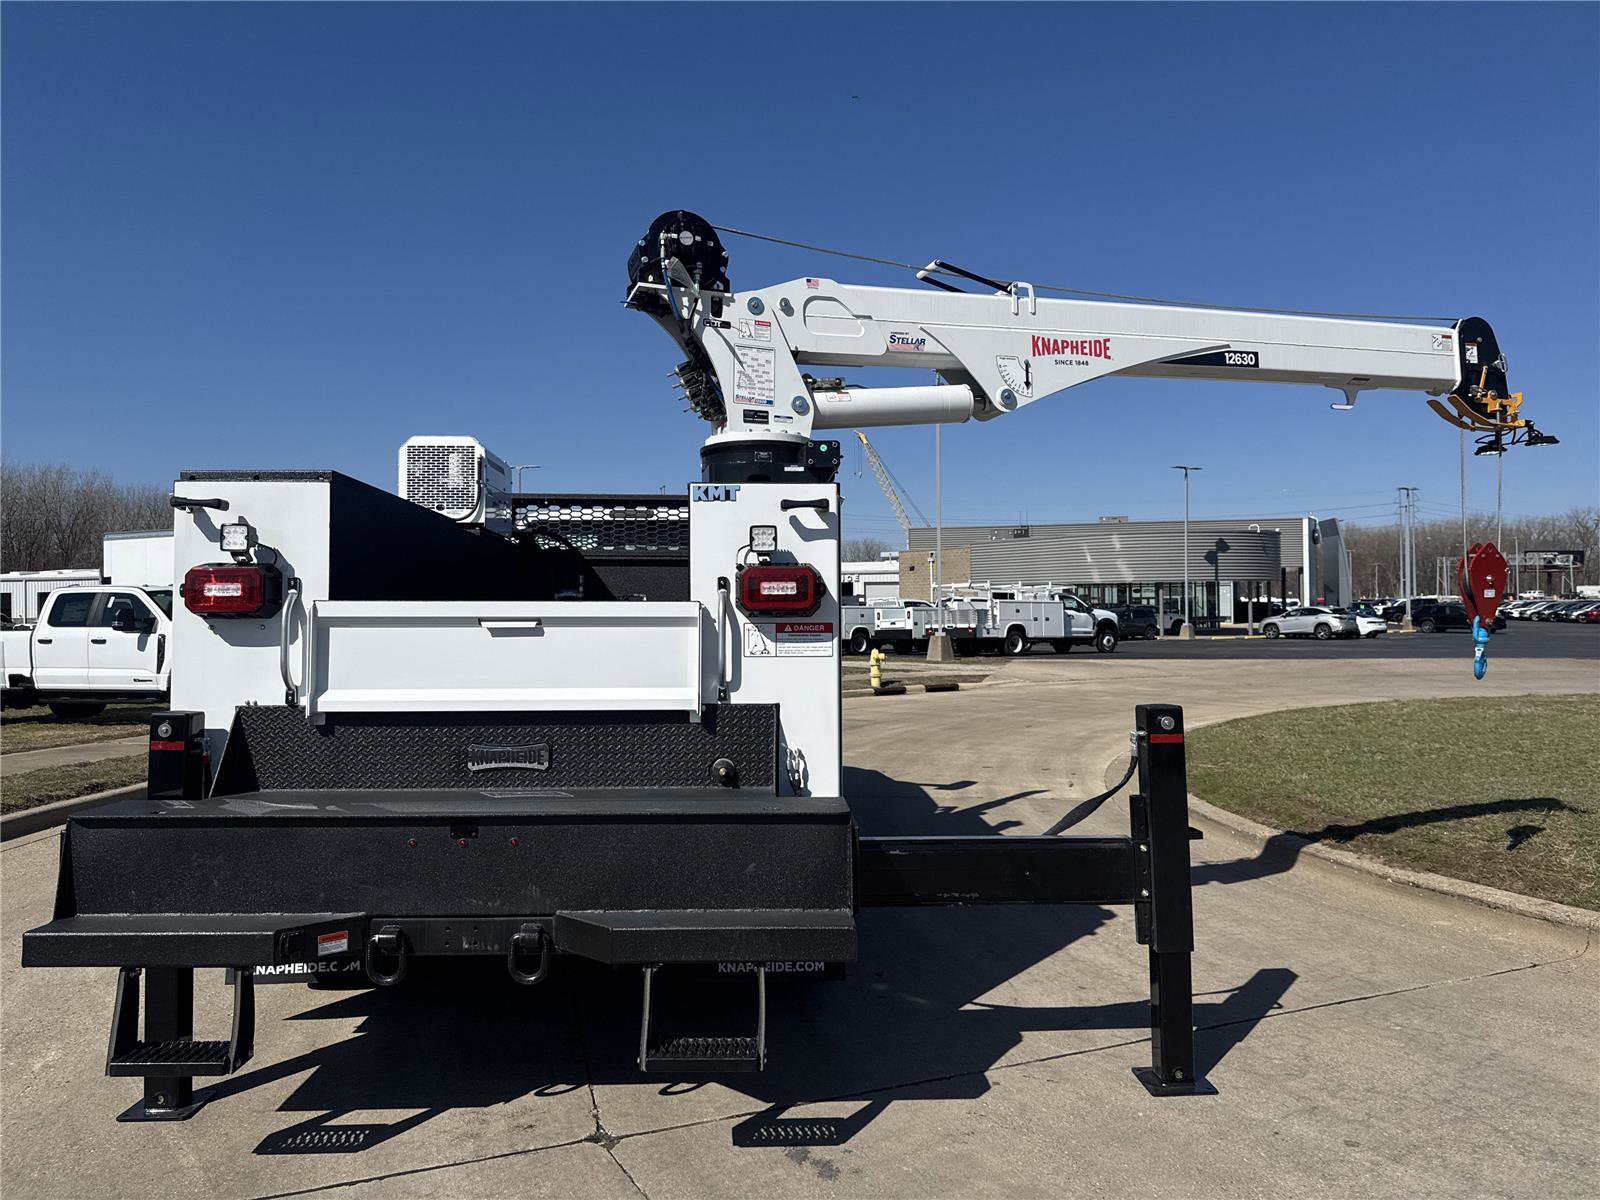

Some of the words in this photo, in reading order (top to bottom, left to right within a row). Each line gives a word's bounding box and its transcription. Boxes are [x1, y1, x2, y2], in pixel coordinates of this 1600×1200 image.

[889, 334, 926, 346] STELLAR
[1031, 335, 1111, 361] KNAPHEIDE
[1224, 352, 1256, 366] 12630
[692, 485, 741, 502] KMT
[793, 624, 825, 632] DANGER
[253, 960, 361, 976] NAPHEIDE.CM
[718, 961, 825, 973] KNAPEIDE.COM
